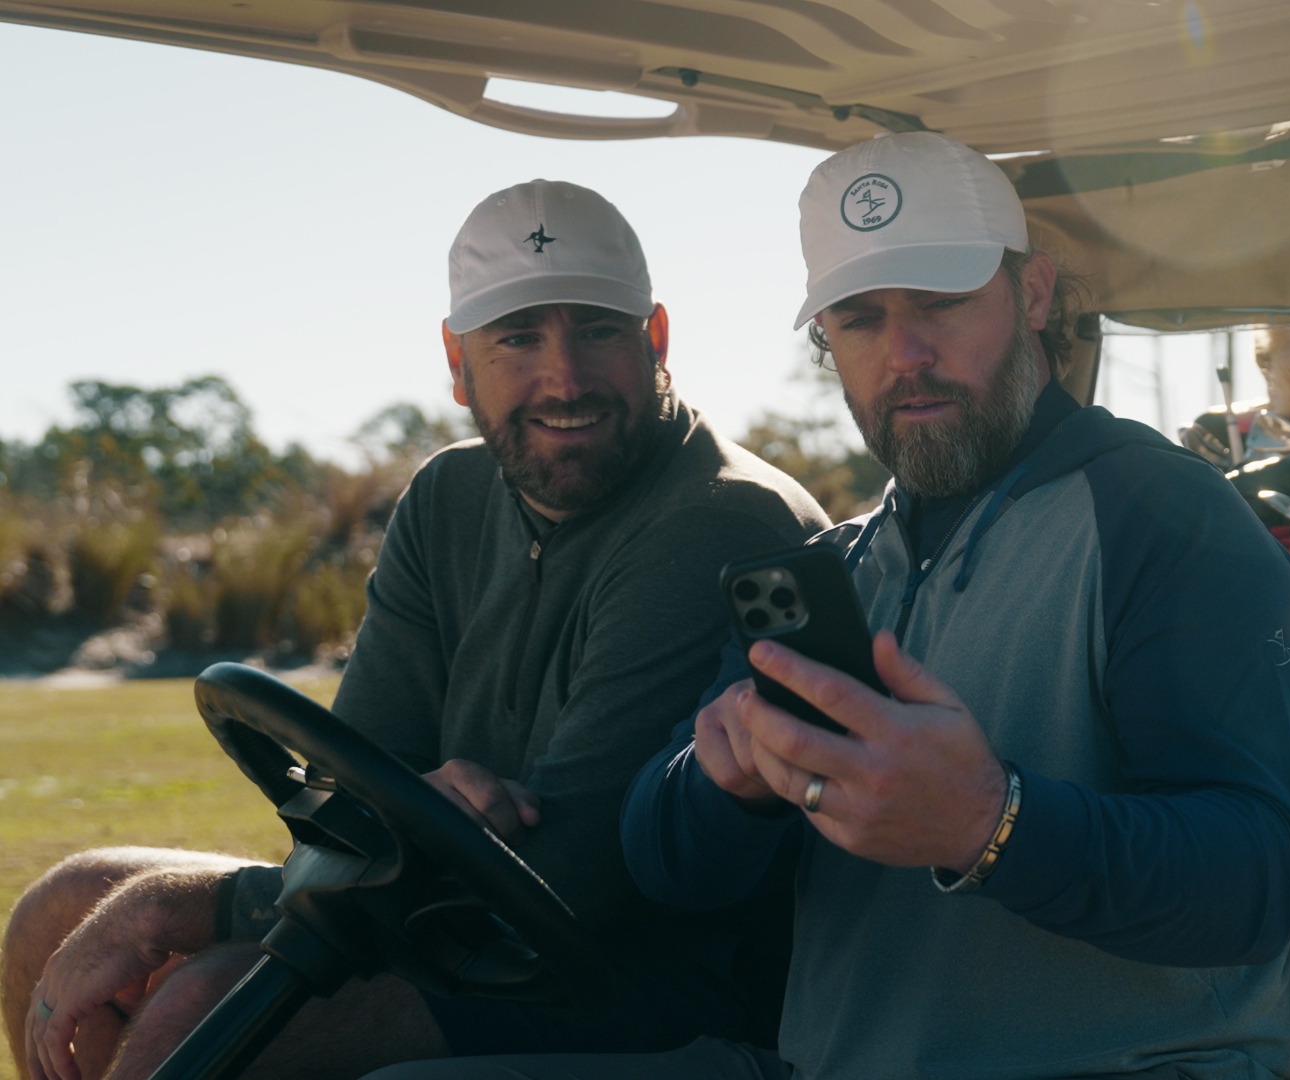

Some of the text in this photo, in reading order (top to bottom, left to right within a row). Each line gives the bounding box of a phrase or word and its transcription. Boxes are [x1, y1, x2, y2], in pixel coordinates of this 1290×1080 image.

[850, 179, 889, 197] SANTA ROSA
[862, 215, 882, 225] 1969
